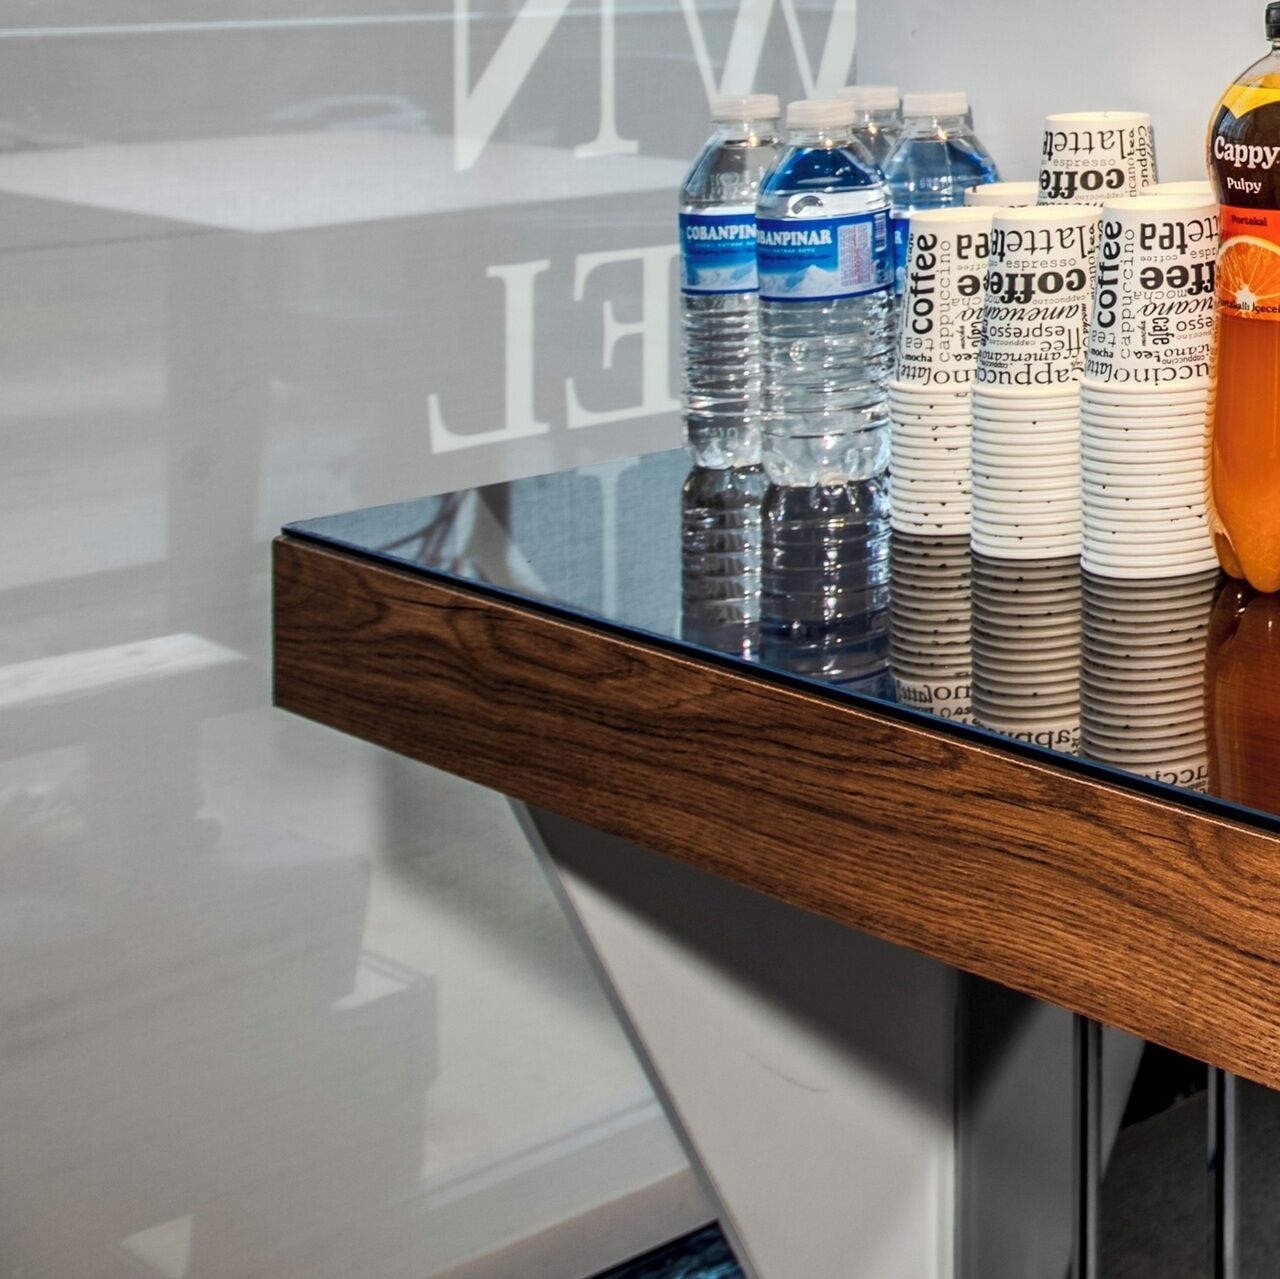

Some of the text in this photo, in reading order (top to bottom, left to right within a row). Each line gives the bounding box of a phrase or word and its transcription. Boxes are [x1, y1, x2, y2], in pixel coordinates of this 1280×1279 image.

[1055, 129, 1127, 159] latte
[1214, 136, 1280, 169] Cappy
[1053, 158, 1116, 169] espresso
[1040, 169, 1124, 199] coffe
[1227, 177, 1262, 193] Pulpy
[1006, 226, 1087, 259] latte
[1140, 222, 1188, 255] tea
[1006, 258, 1076, 271] espresso
[1097, 221, 1122, 328] coffee
[1140, 260, 1216, 295] ffee
[910, 234, 937, 334] coffee
[1121, 229, 1135, 359] cappuccino
[1133, 290, 1188, 303] mocha
[939, 241, 953, 363] cappuccino
[906, 337, 934, 352] tea
[989, 323, 1065, 338] espresso
[1152, 317, 1175, 346] cafe
[904, 354, 932, 363] mocha
[1133, 350, 1160, 363] tea
